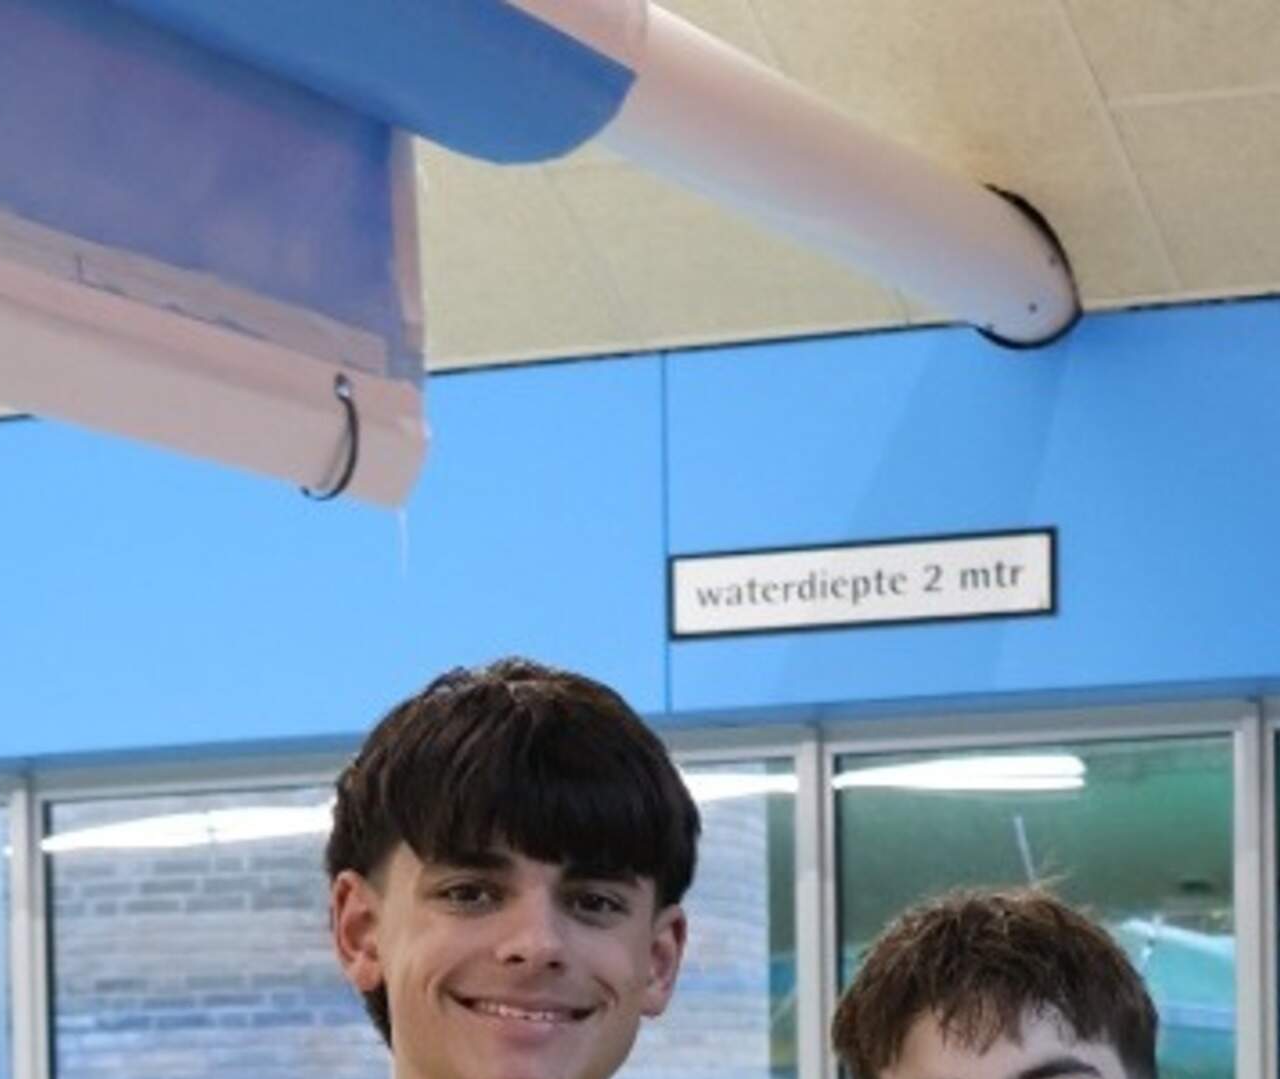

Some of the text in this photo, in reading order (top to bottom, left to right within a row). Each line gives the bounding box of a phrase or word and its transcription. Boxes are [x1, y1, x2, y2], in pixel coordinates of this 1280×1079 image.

[695, 560, 1025, 607] waterdiepte 2 mtr
